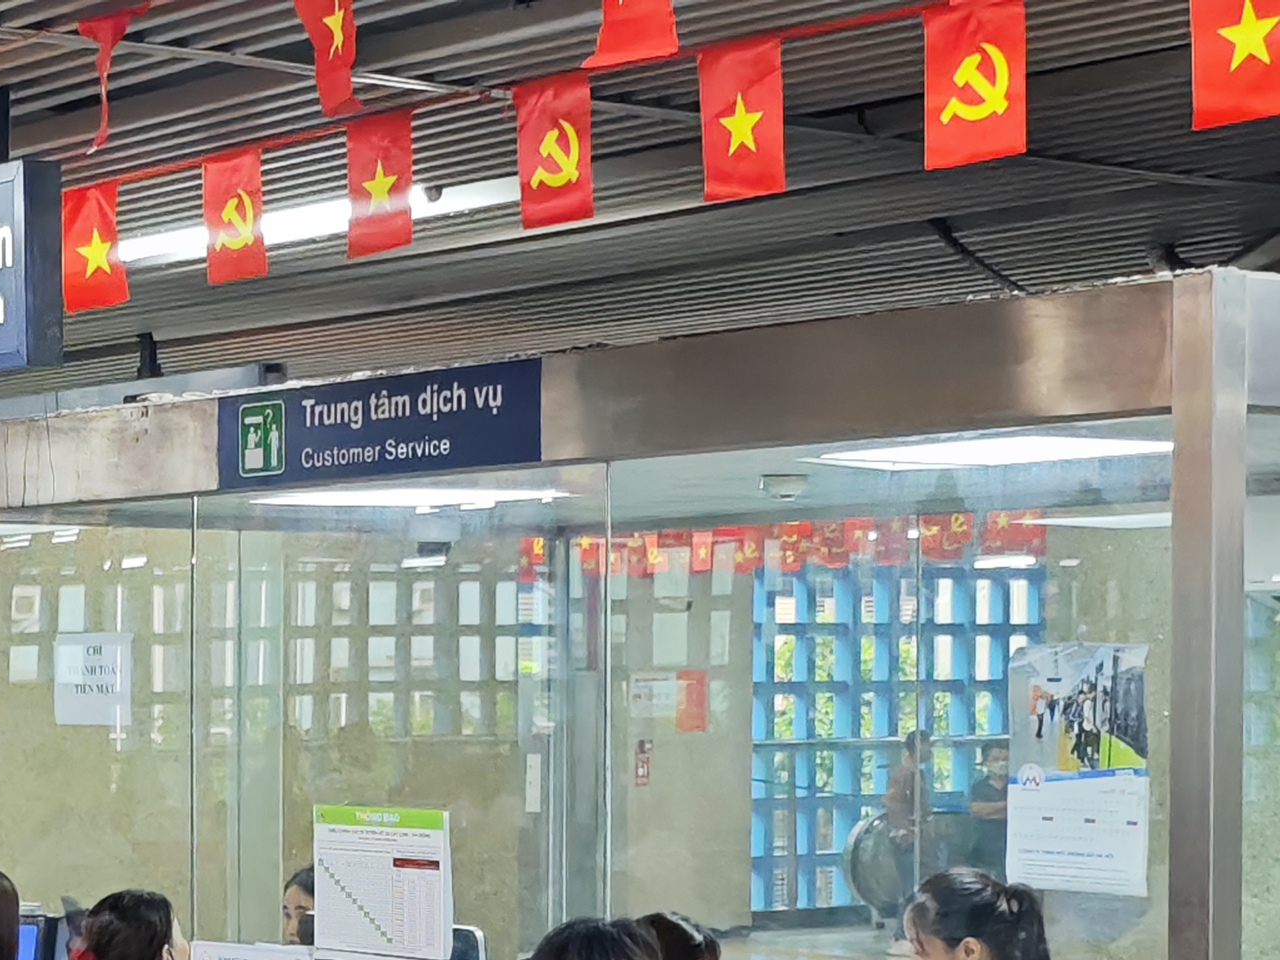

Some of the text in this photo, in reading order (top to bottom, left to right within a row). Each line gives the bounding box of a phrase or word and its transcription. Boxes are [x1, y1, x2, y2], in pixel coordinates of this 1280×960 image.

[301, 381, 503, 430] Trung tâm dịch vụ
[301, 435, 451, 469] Customer Service
